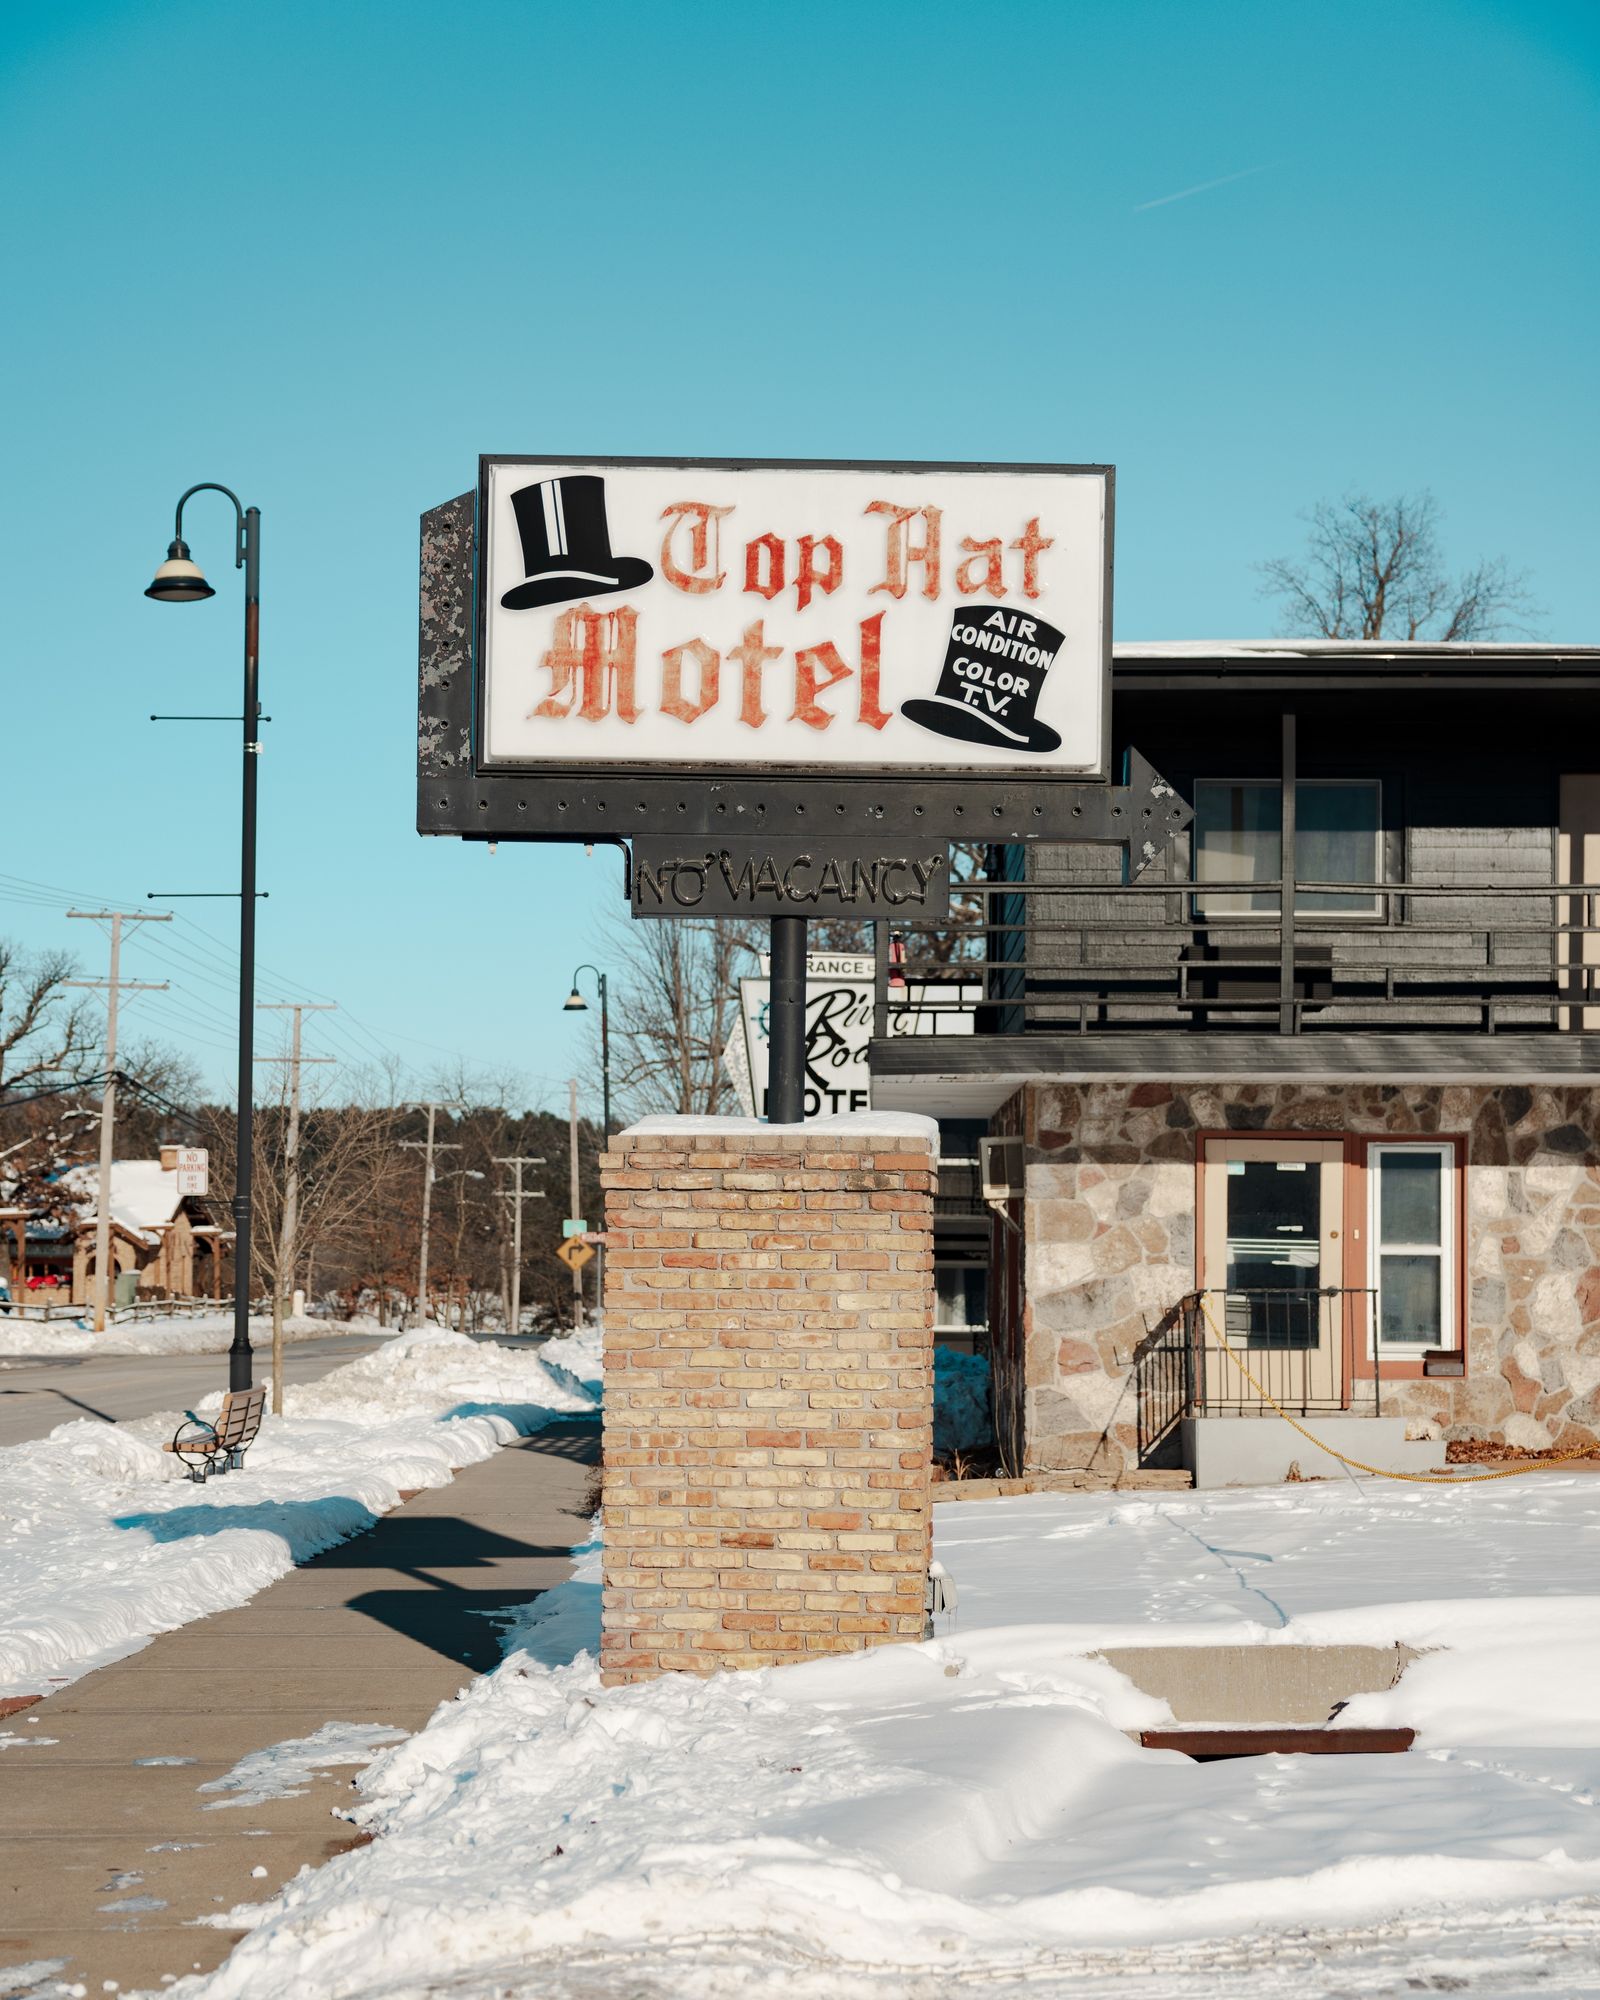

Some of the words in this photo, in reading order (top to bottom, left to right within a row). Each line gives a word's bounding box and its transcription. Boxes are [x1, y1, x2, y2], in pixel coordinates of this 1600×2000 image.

[660, 501, 844, 612] Top
[863, 500, 1054, 600] Hat
[983, 610, 1037, 642] AIR
[526, 602, 894, 730] Motel
[951, 623, 1054, 671] CONDITION
[952, 657, 1030, 698] COLOR
[960, 681, 1012, 716] T.V.
[635, 858, 714, 906] NO
[720, 850, 943, 905] VACANCY
[769, 961, 863, 974] RANCE
[806, 1031, 869, 1090] Roa
[180, 1164, 206, 1172] PARKING
[186, 1153, 198, 1162] NO
